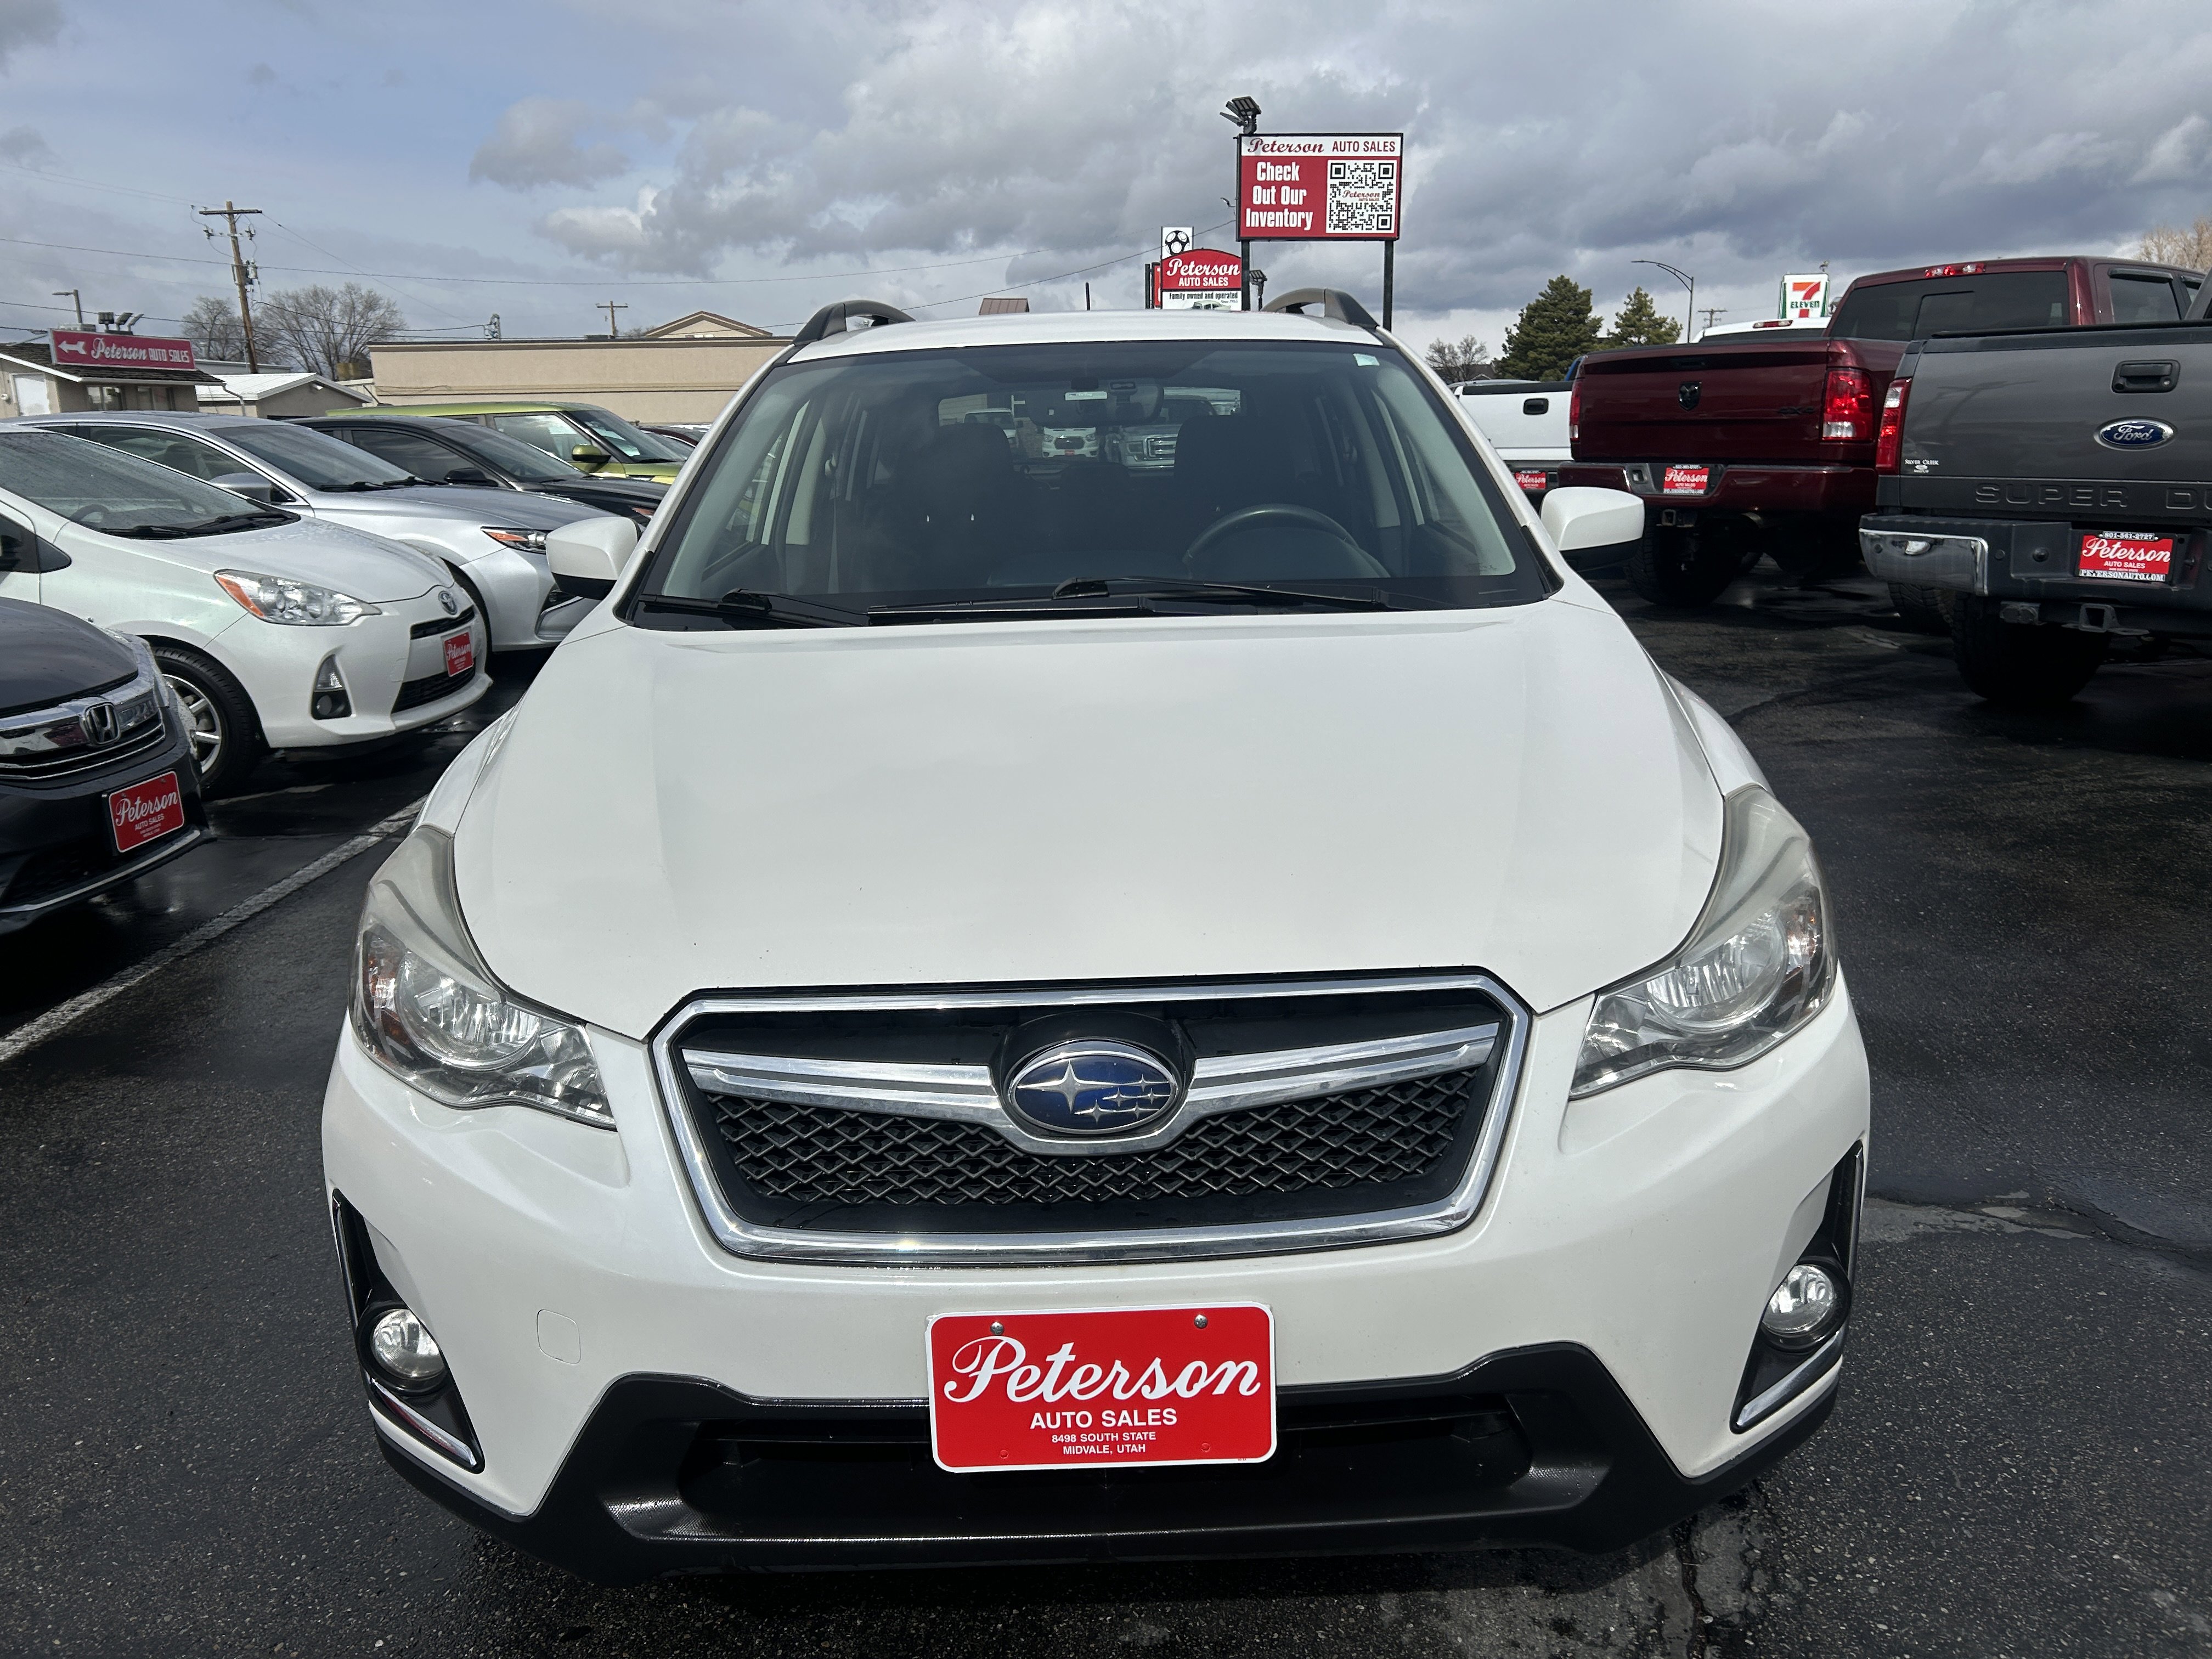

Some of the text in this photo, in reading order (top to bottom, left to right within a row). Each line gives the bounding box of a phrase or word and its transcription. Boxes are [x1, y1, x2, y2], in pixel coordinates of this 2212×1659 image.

[1248, 138, 1395, 153] Peterson AUTO SALES
[1256, 162, 1300, 182] Check
[1252, 185, 1307, 205] Out Our
[1246, 208, 1313, 231] Inventory
[1166, 258, 1240, 276] Peterson
[1178, 276, 1229, 286] AUTO SALES
[1215, 292, 1238, 300] operated
[91, 337, 190, 363] Peterson AUTO SALES
[2113, 425, 2154, 441] Ford
[1976, 483, 2128, 508] SUPER
[2082, 538, 2171, 562] Peterson
[115, 792, 178, 827] Peterson
[135, 820, 148, 831] AUTO
[149, 813, 165, 825] SALES
[944, 1335, 1262, 1403] Peterson
[1030, 1408, 1177, 1429] AUTO SALES
[1052, 1431, 1156, 1443] 8498 SOUTH STATE
[1063, 1443, 1146, 1455] MIDVALE, UTAH
